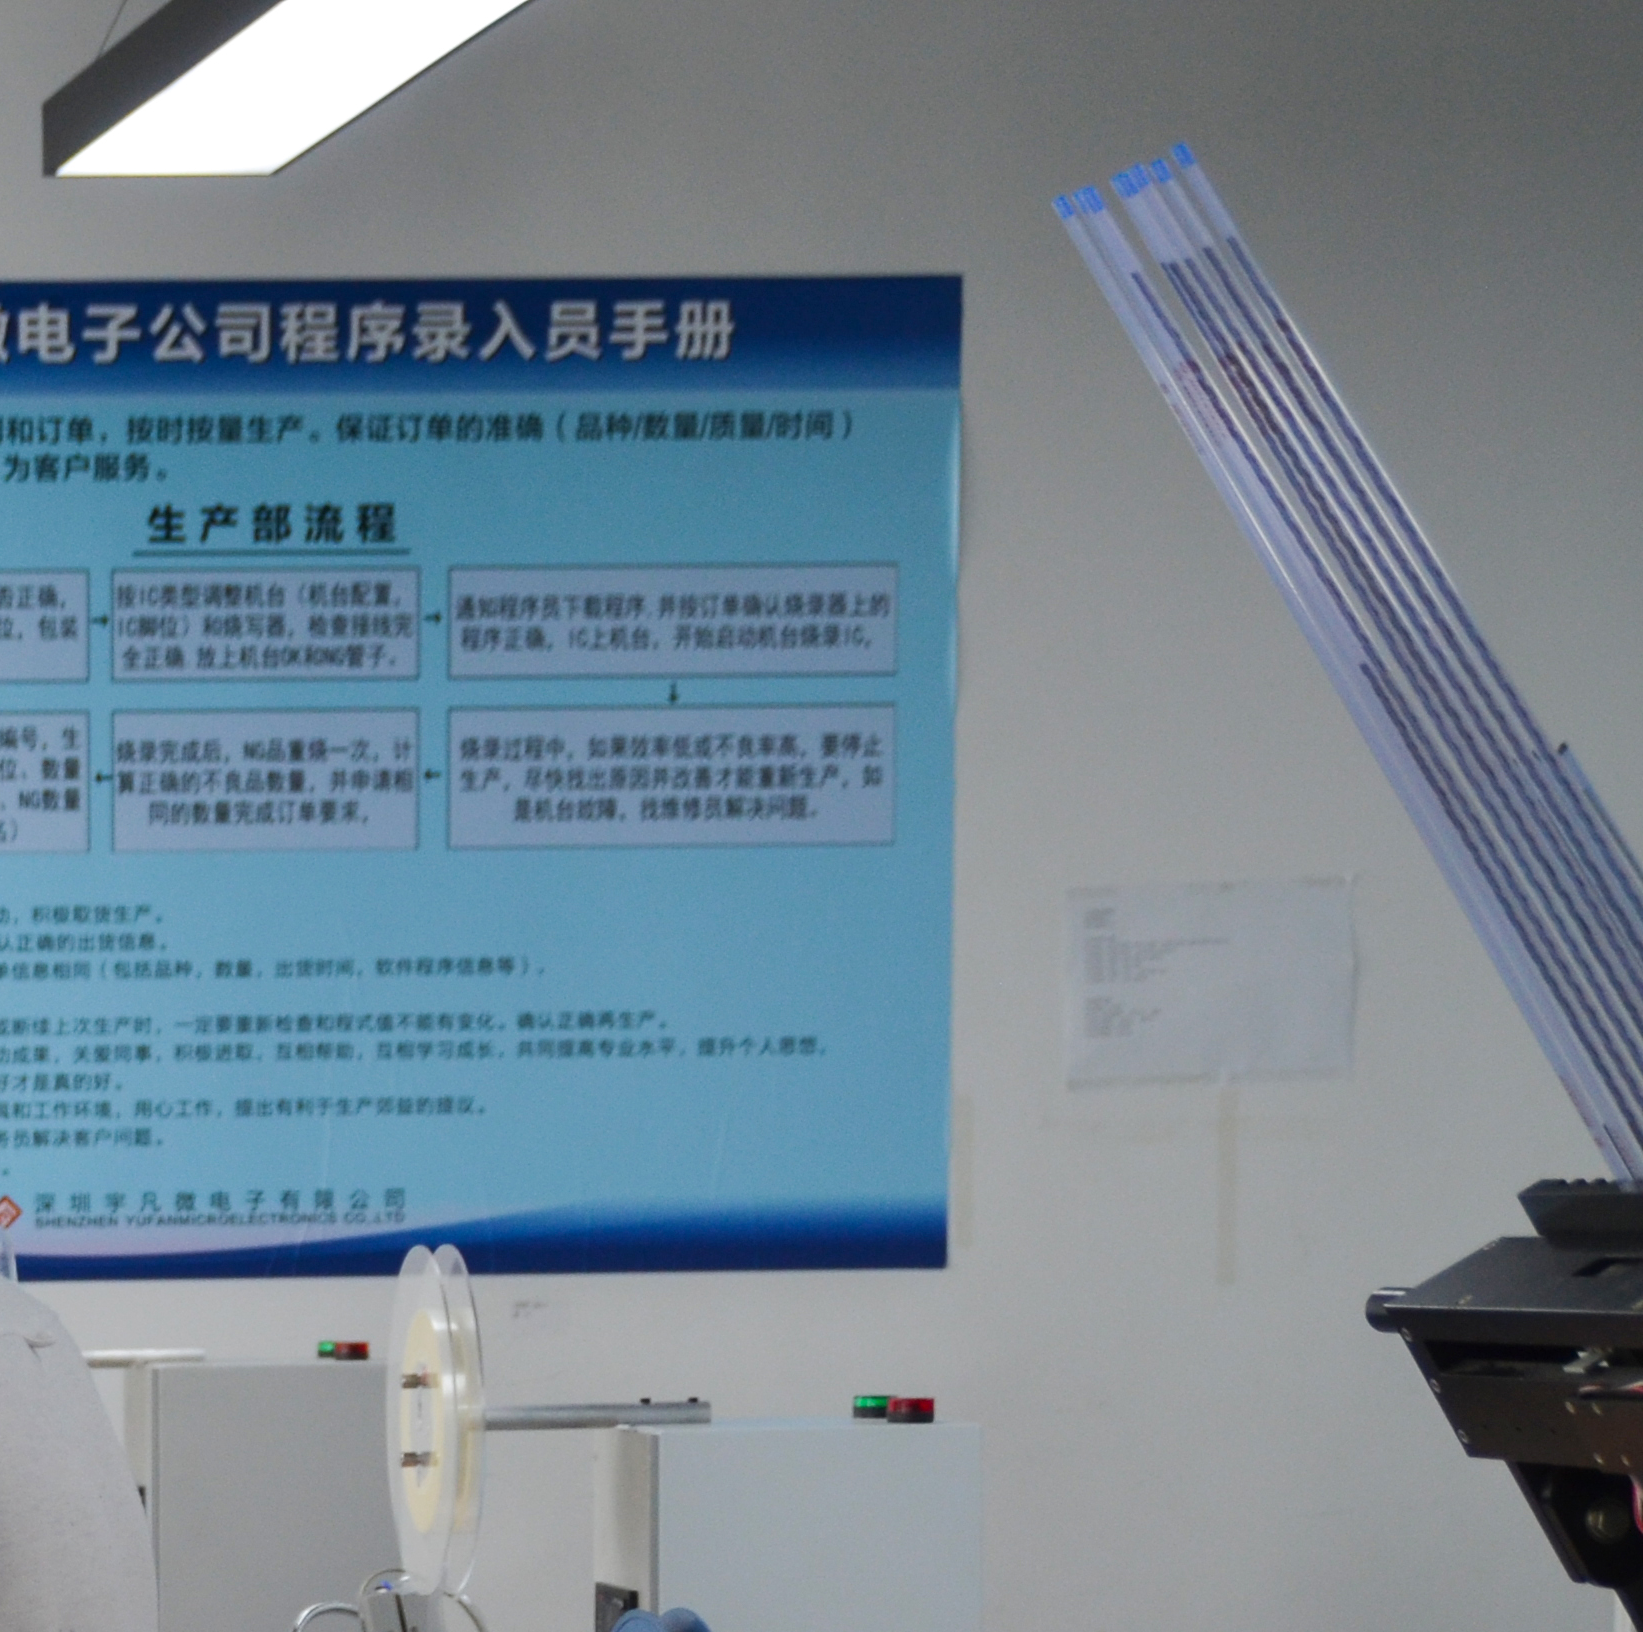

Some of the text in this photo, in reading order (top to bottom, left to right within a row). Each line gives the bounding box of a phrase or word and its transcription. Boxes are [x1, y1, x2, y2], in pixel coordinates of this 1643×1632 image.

[147, 502, 397, 544] 生产部流程
[34, 1187, 405, 1214] 深圳宇凡微电子有限公司
[34, 1214, 118, 1229] SHENZHEN
